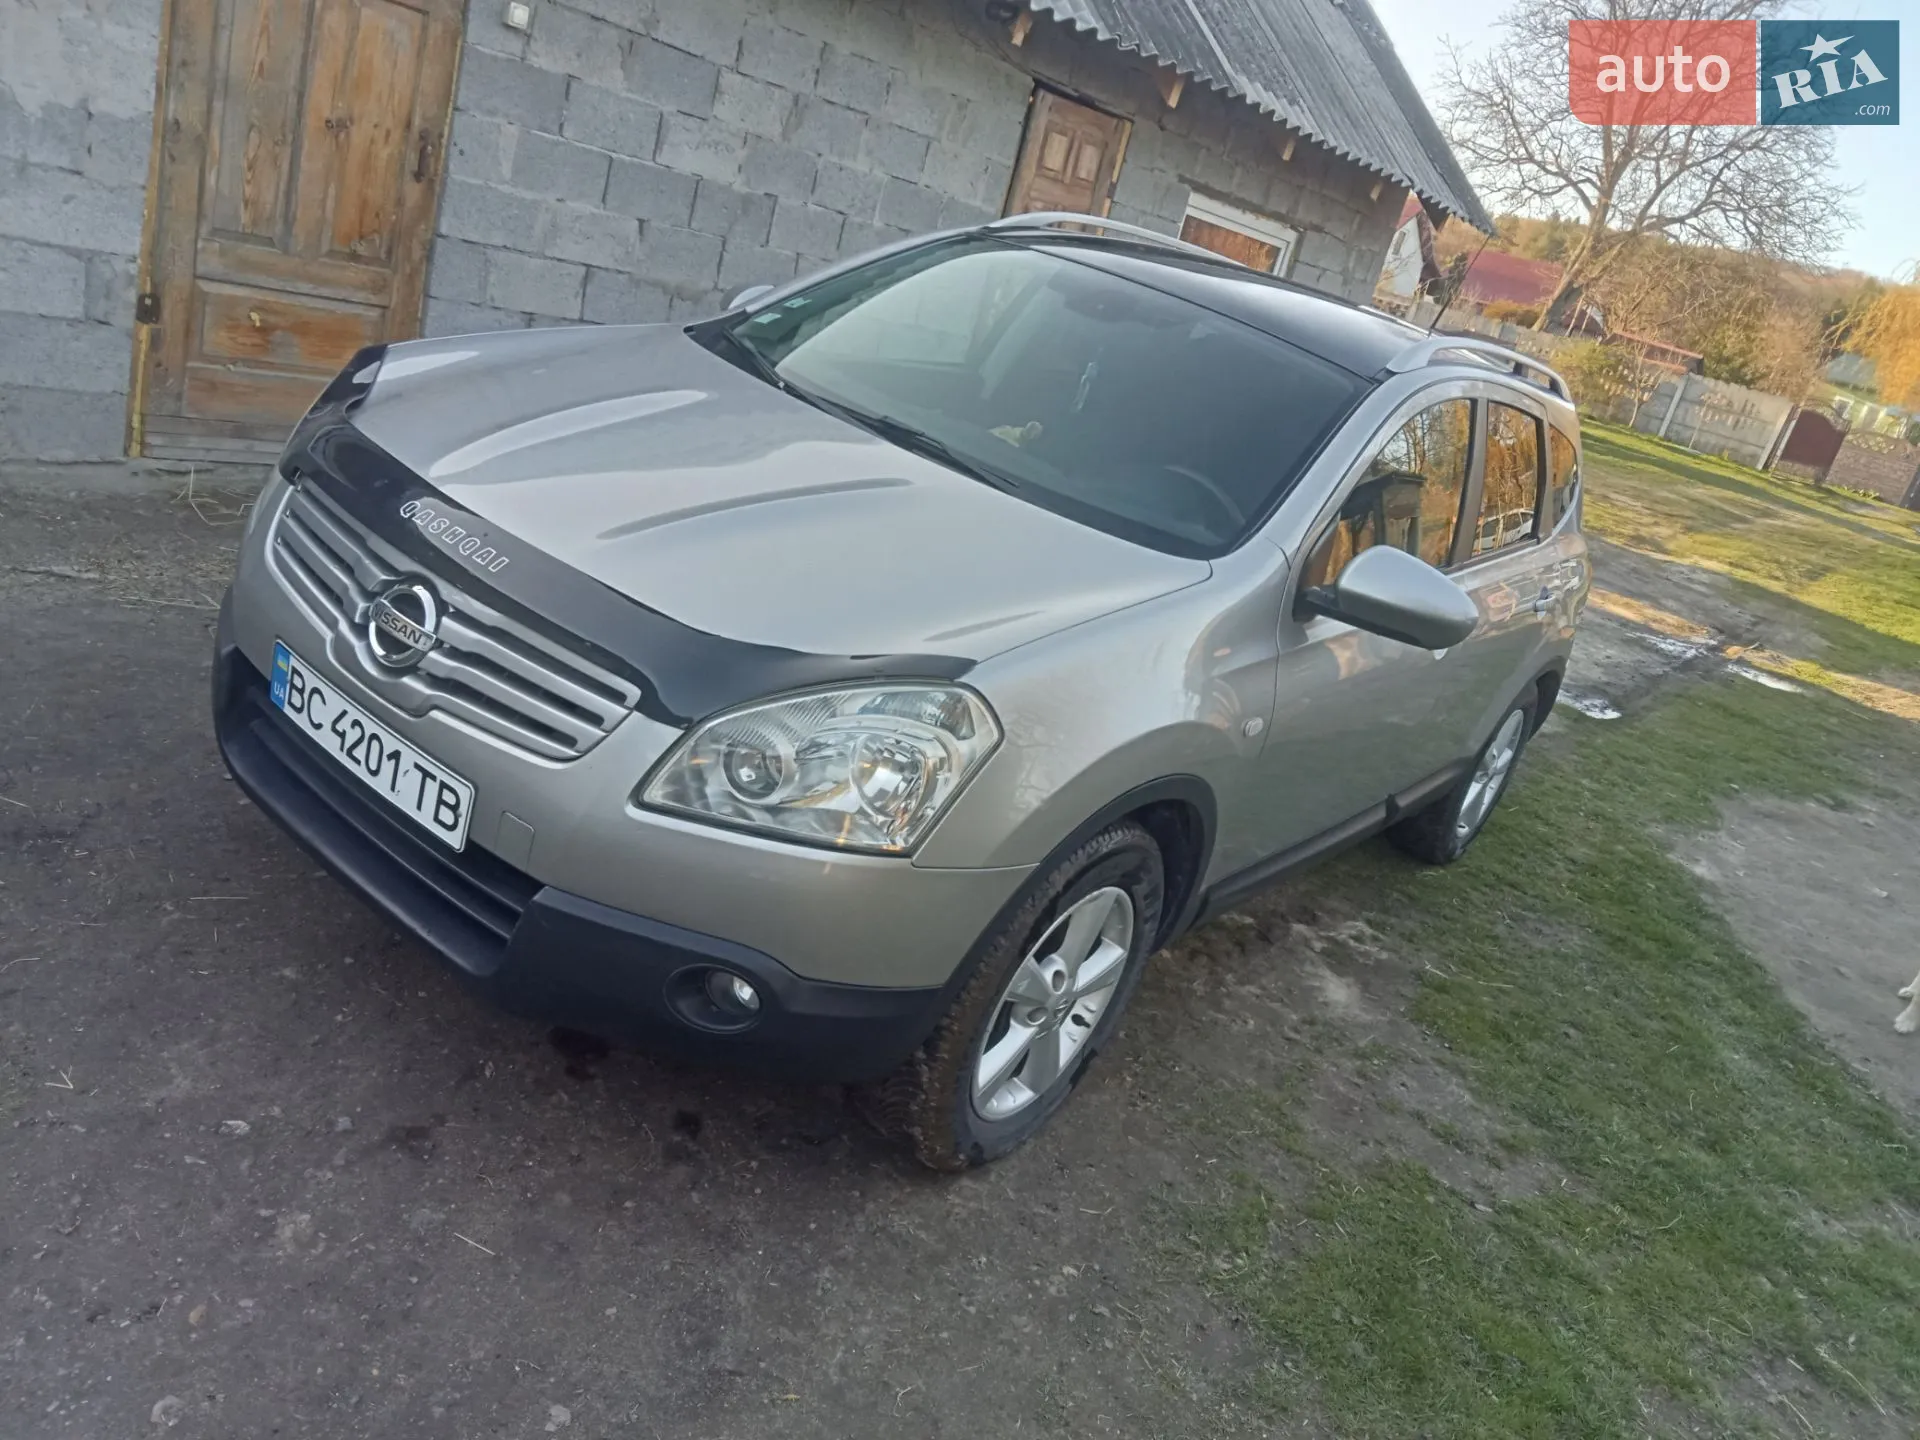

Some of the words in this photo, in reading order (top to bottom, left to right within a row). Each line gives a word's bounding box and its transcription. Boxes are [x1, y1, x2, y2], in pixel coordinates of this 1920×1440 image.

[400, 501, 510, 573] QASHQAI
[372, 602, 422, 644] NISSAN
[274, 682, 285, 700] UA
[287, 665, 326, 730] BC
[331, 709, 402, 793] 4201
[413, 761, 461, 832] TB
